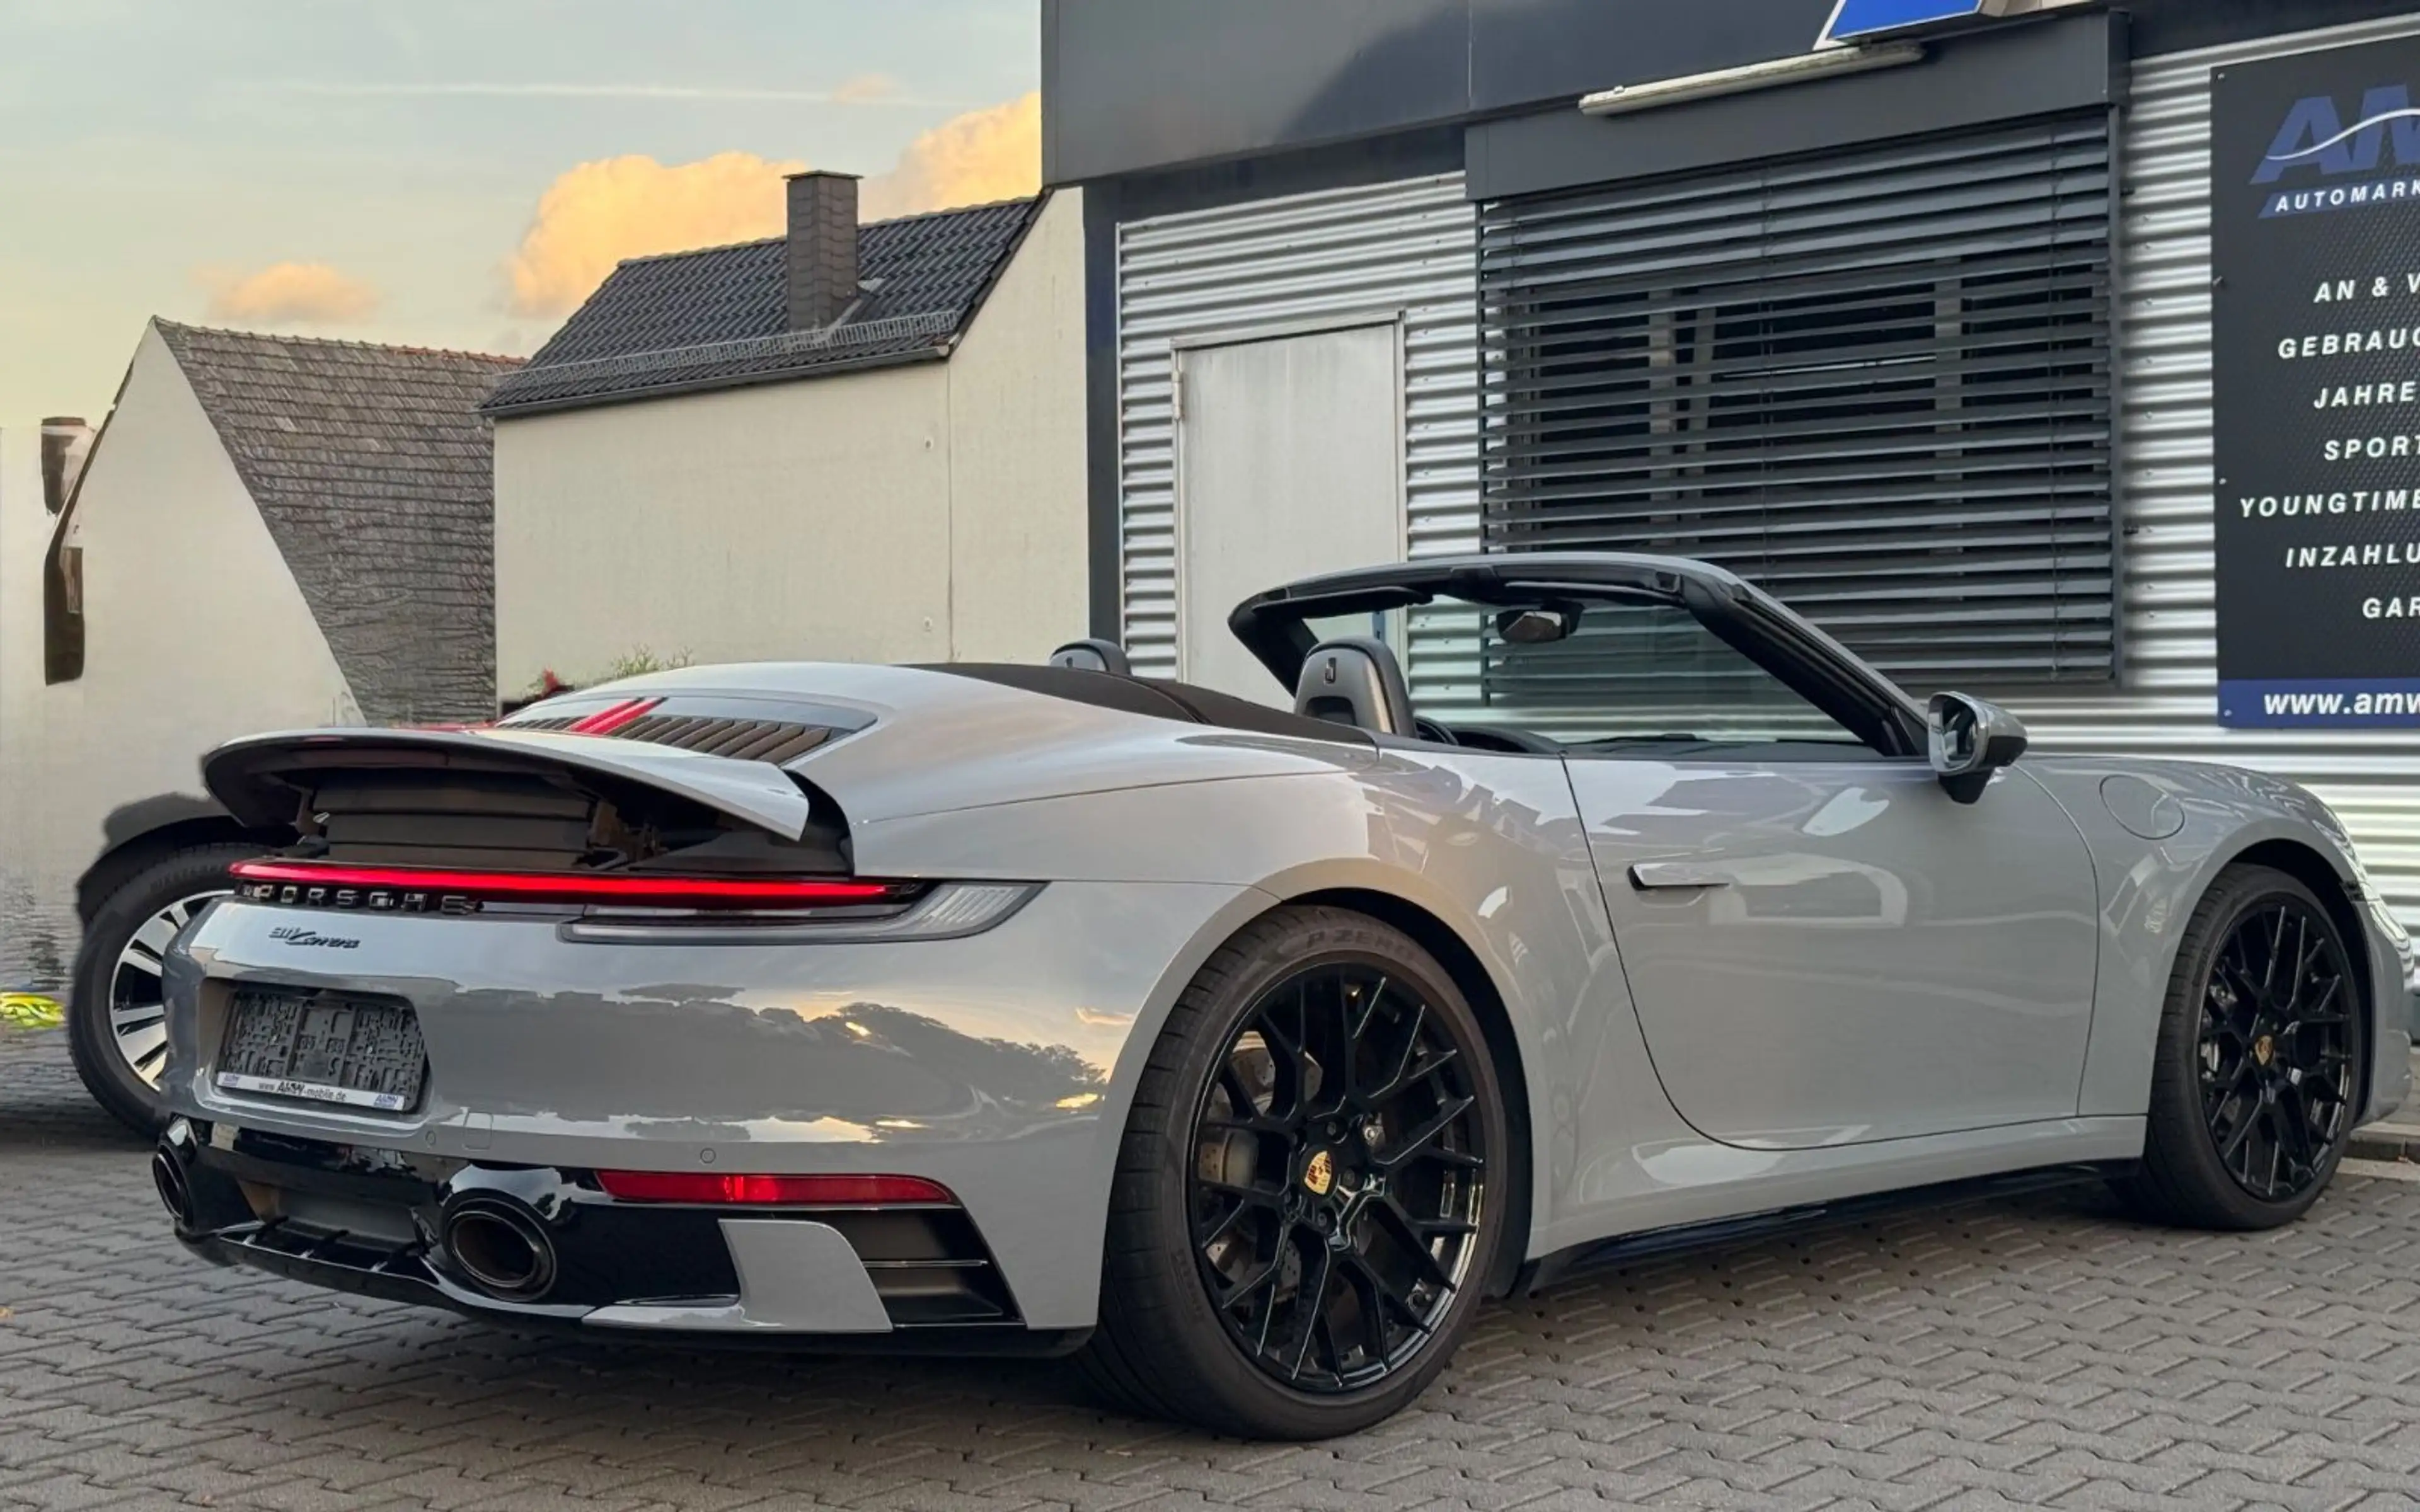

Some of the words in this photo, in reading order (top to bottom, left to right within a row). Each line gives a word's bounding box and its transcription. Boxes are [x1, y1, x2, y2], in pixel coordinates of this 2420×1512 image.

[2313, 280, 2355, 303] AN
[2371, 276, 2389, 297] &
[2313, 381, 2416, 409] JAHRE
[2286, 542, 2420, 568] INZAHLU
[2363, 596, 2420, 619] GAR
[253, 883, 470, 915] PORSCHE
